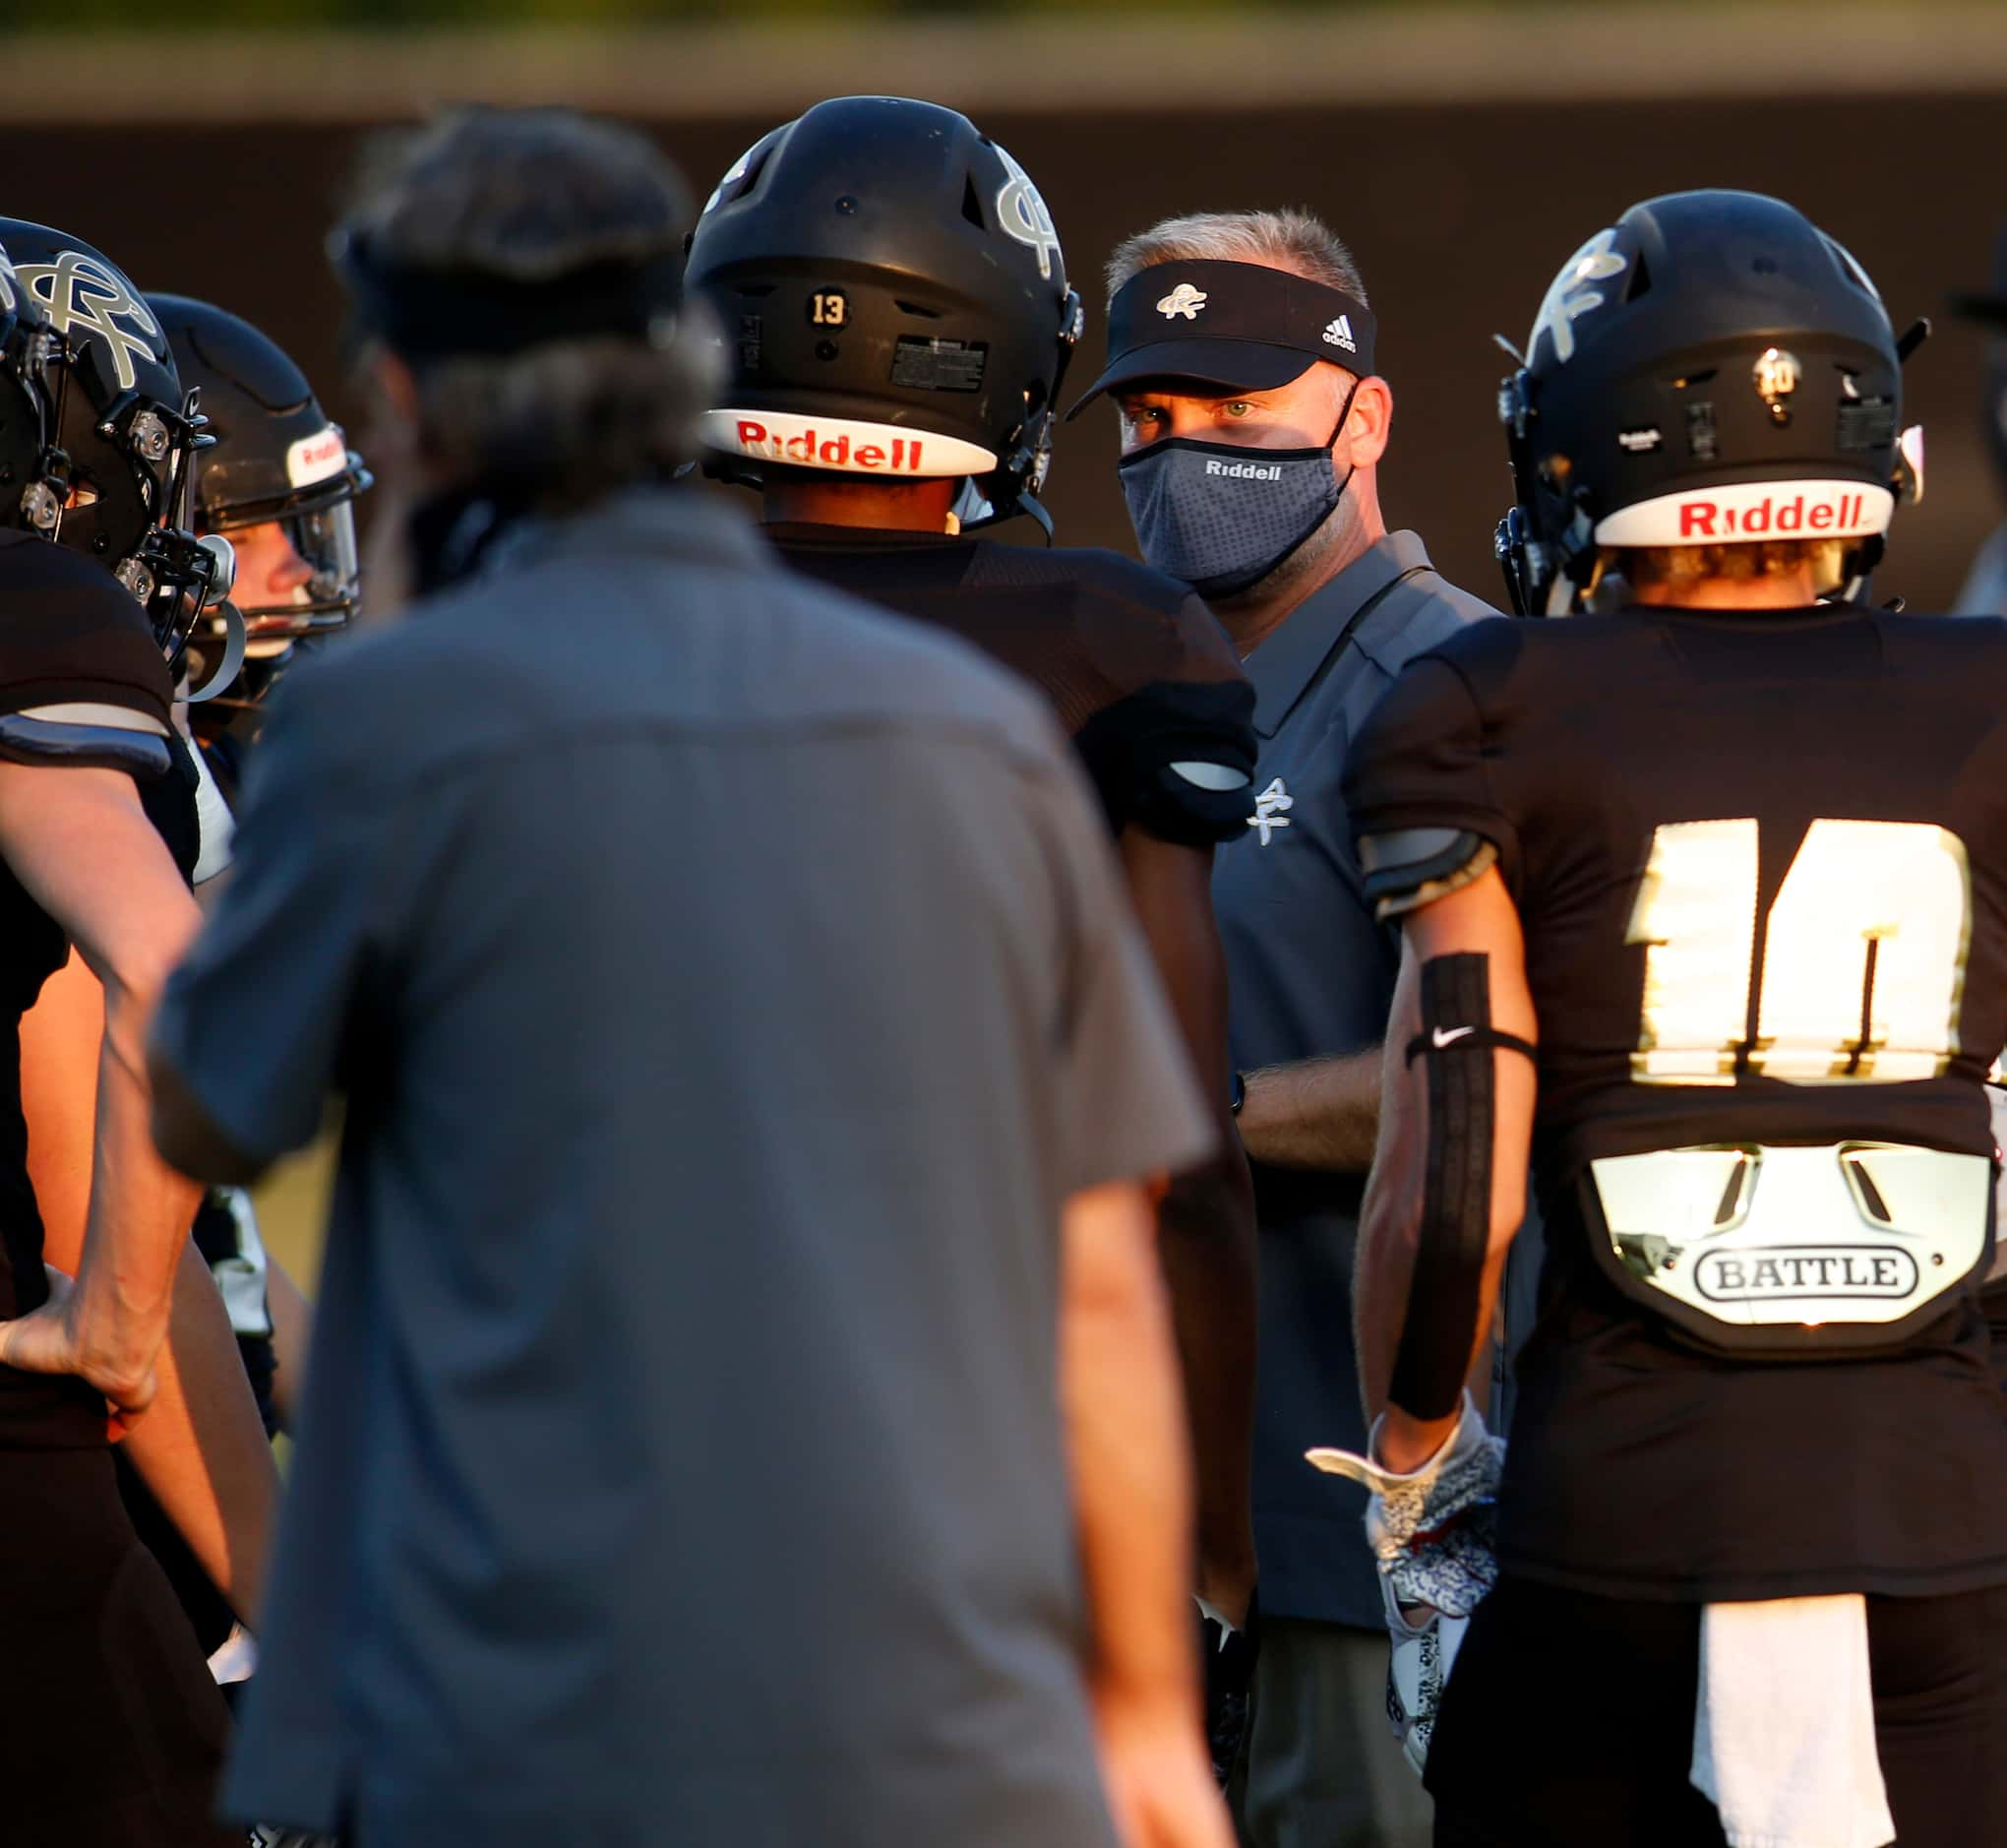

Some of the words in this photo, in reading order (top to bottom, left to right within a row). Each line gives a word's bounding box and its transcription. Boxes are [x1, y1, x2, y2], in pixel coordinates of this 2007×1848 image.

[813, 294, 844, 324] 13
[1321, 332, 1356, 353] adidas
[737, 420, 923, 470] Riddell
[1205, 460, 1282, 481] Riddell
[1680, 495, 1863, 537] Riddell
[1624, 818, 1973, 1086] 10
[1715, 1257, 1899, 1289] BATTLE
